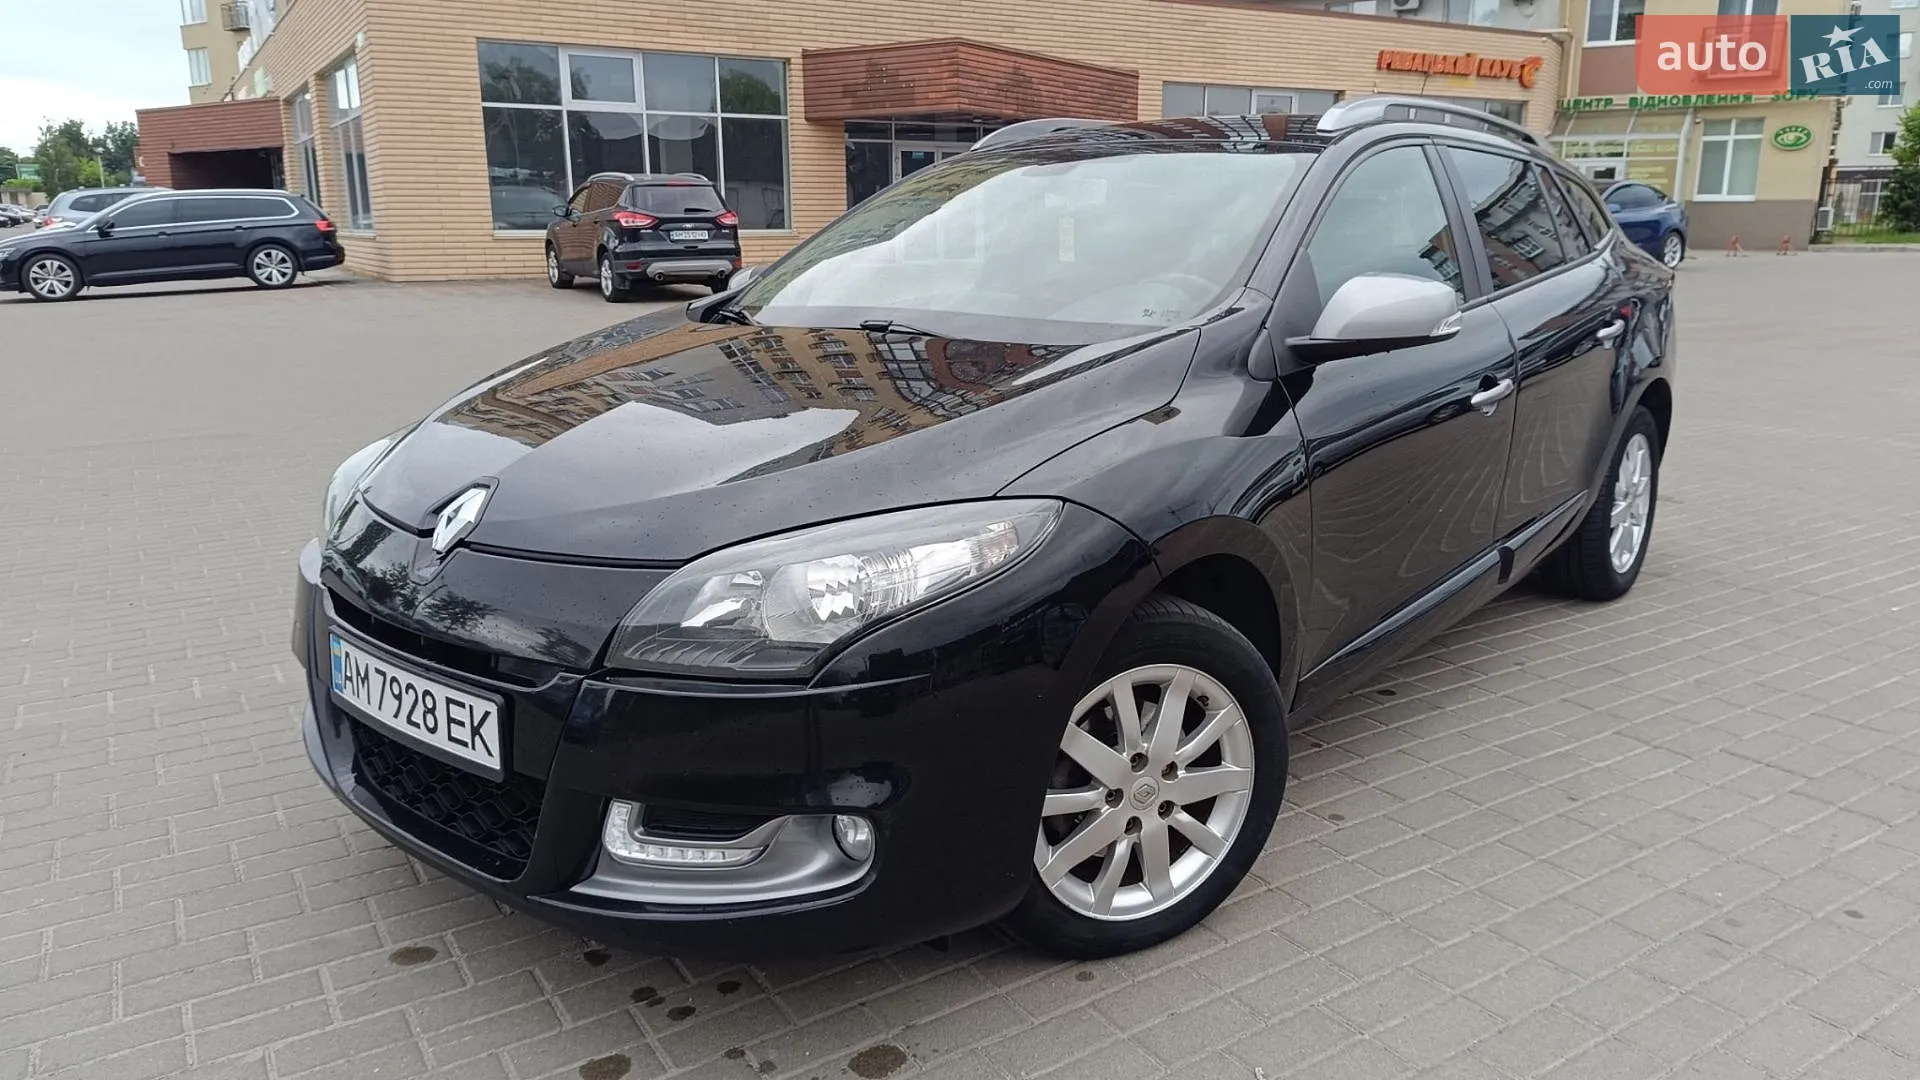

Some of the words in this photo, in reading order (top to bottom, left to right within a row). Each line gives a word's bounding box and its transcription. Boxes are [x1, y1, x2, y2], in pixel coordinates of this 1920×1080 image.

[1478, 58, 1522, 79] КЛУБ
[1560, 96, 1614, 112] ЦЕНТР
[1627, 92, 1753, 110] ВІДНОВЛЕННЯ
[374, 667, 439, 735] 7928
[445, 695, 495, 758] EK
